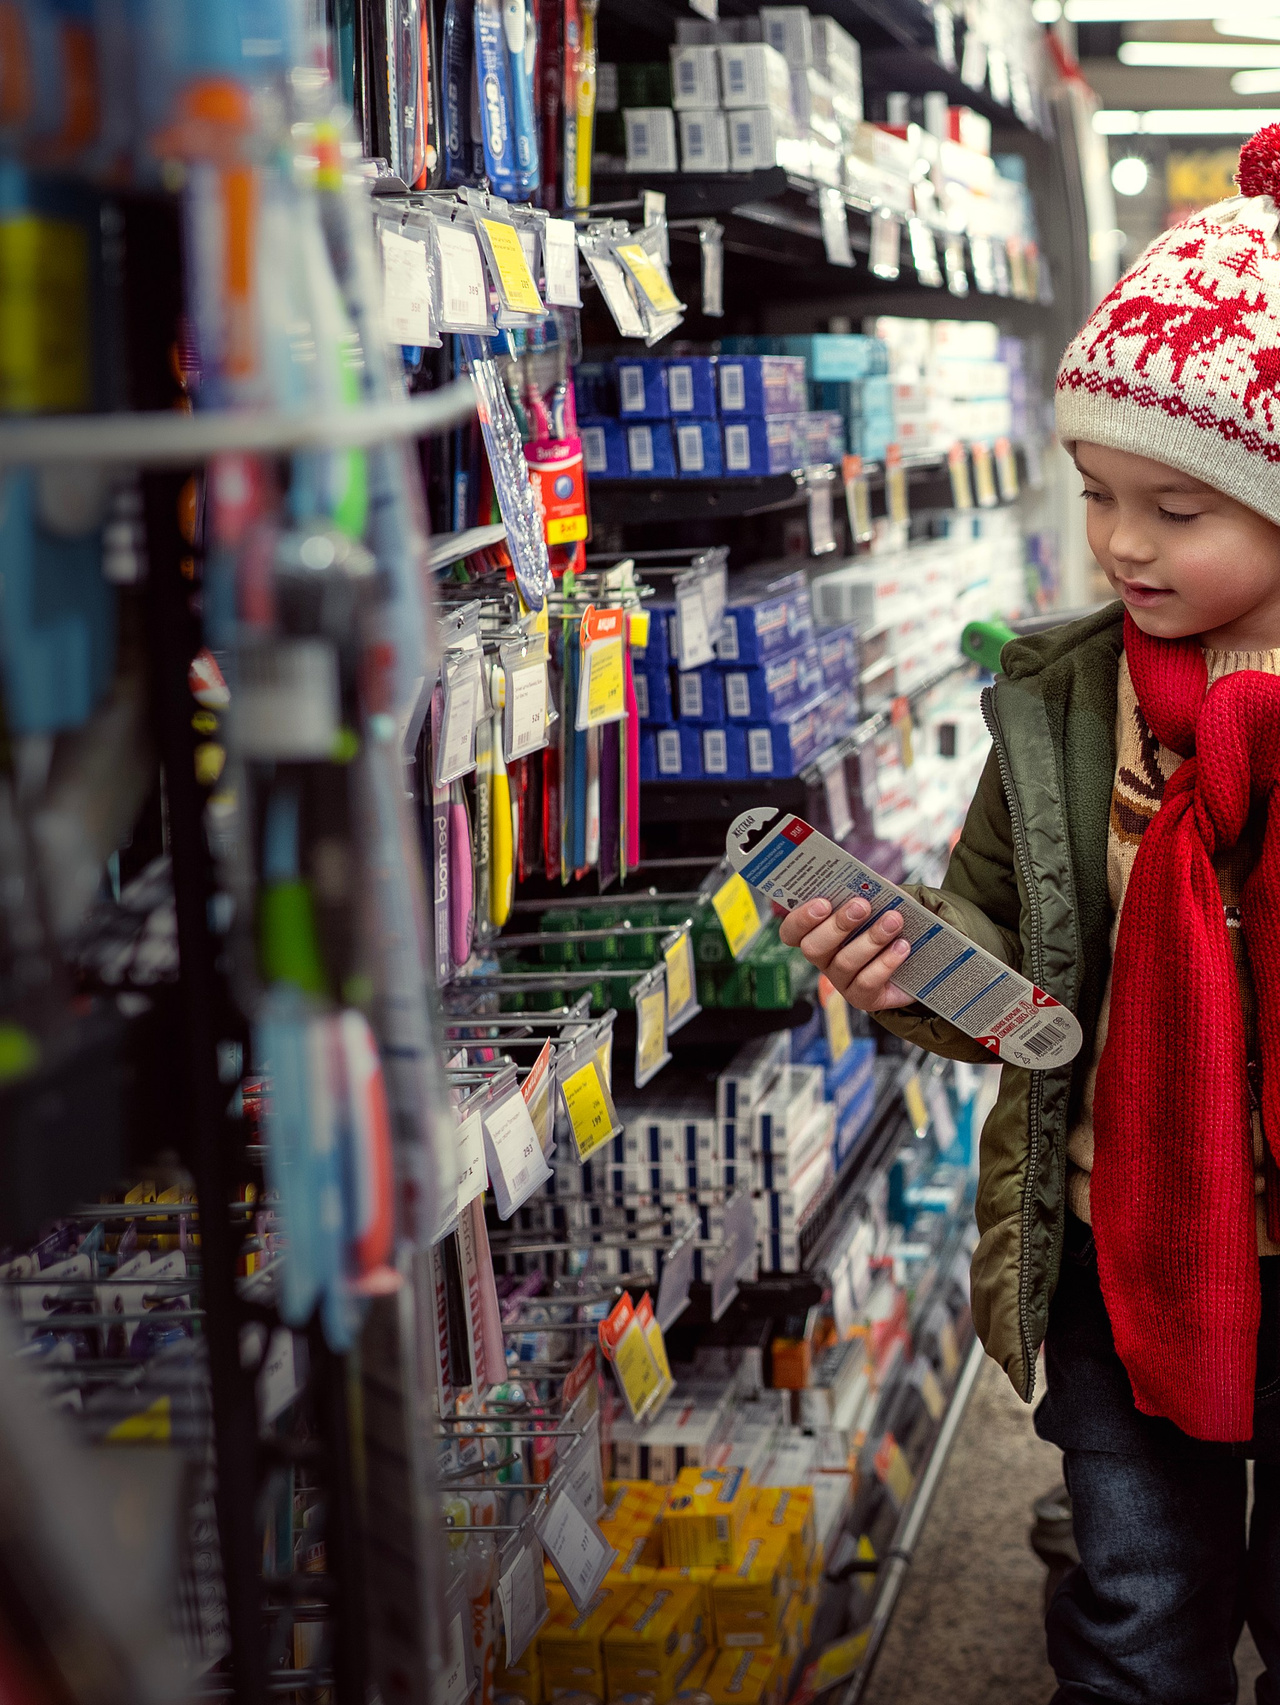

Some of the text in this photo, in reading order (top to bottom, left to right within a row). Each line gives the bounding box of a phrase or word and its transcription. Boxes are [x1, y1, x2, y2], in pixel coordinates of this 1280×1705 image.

[485, 81, 504, 154] Oral-B
[434, 815, 448, 904] biomed
[475, 782, 490, 867] biomed
[731, 815, 756, 839] ЖЕСТКАЯ
[790, 824, 804, 838] SPLAT
[523, 1143, 534, 1158] 293
[591, 1114, 602, 1128] 199
[436, 1281, 452, 1403] LACALUT
[469, 1273, 487, 1396] LACALUT
